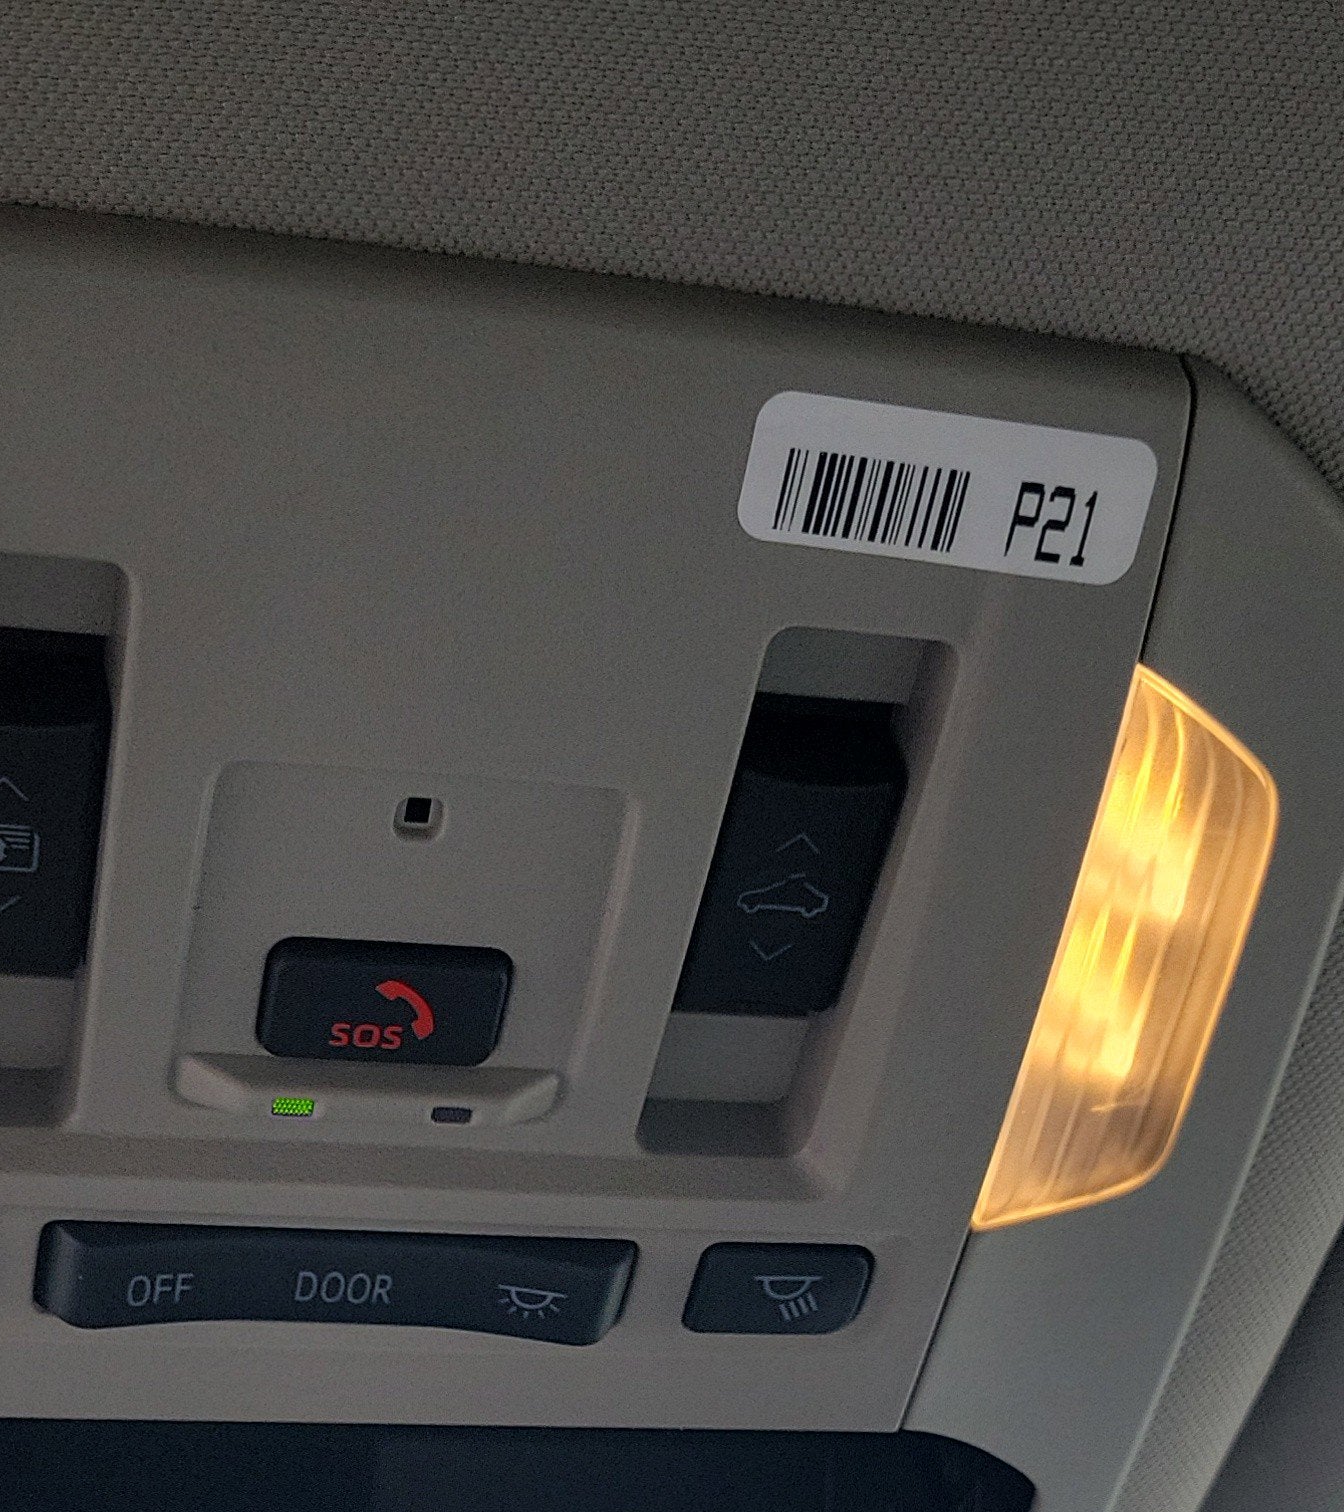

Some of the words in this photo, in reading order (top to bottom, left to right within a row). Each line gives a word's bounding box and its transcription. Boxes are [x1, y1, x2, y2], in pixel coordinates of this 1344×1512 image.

[1003, 480, 1098, 567] P21
[328, 1021, 404, 1050] SOS
[126, 1272, 195, 1307] OFF
[293, 1270, 394, 1305] DOOR
